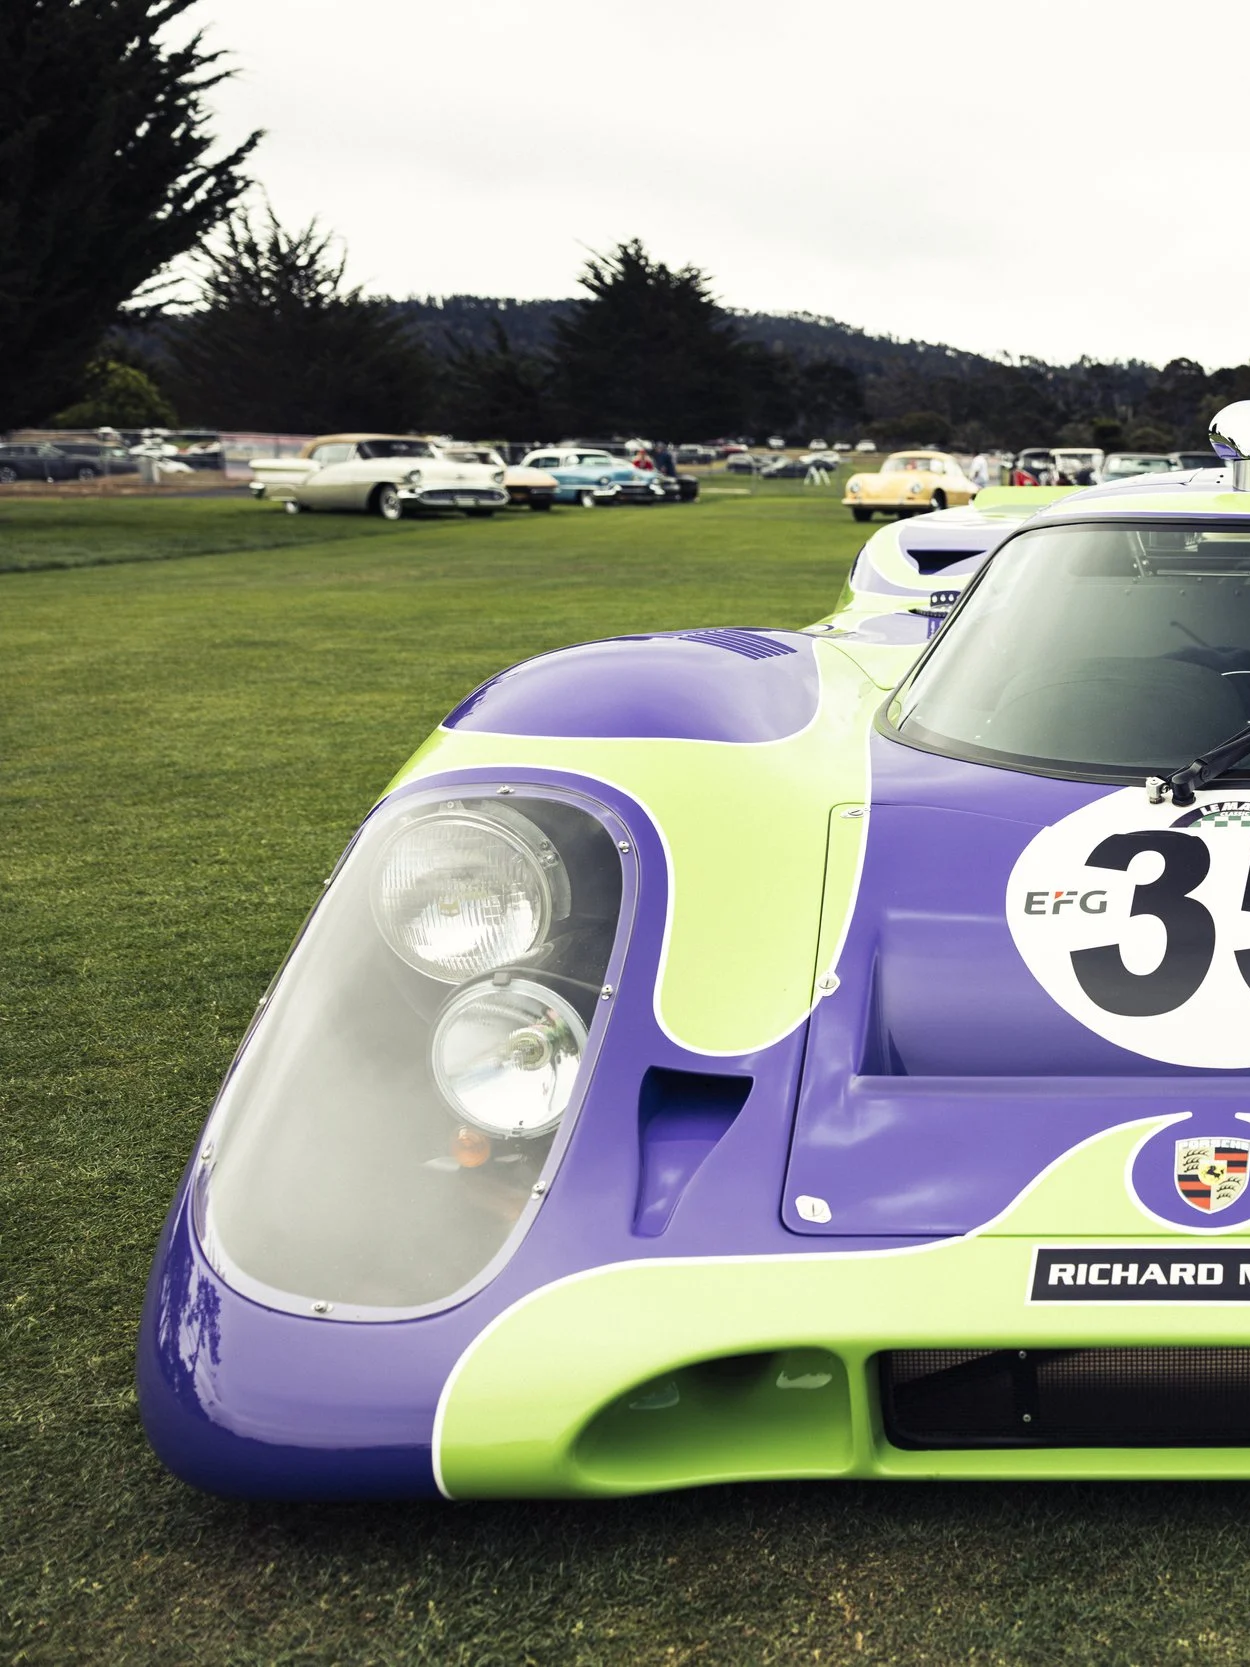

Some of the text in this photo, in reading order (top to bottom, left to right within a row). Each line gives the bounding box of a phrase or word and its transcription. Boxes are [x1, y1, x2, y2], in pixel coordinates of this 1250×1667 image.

[1200, 803, 1220, 816] LE
[1023, 890, 1108, 915] EFG
[1048, 1263, 1224, 1285] RICHARD
